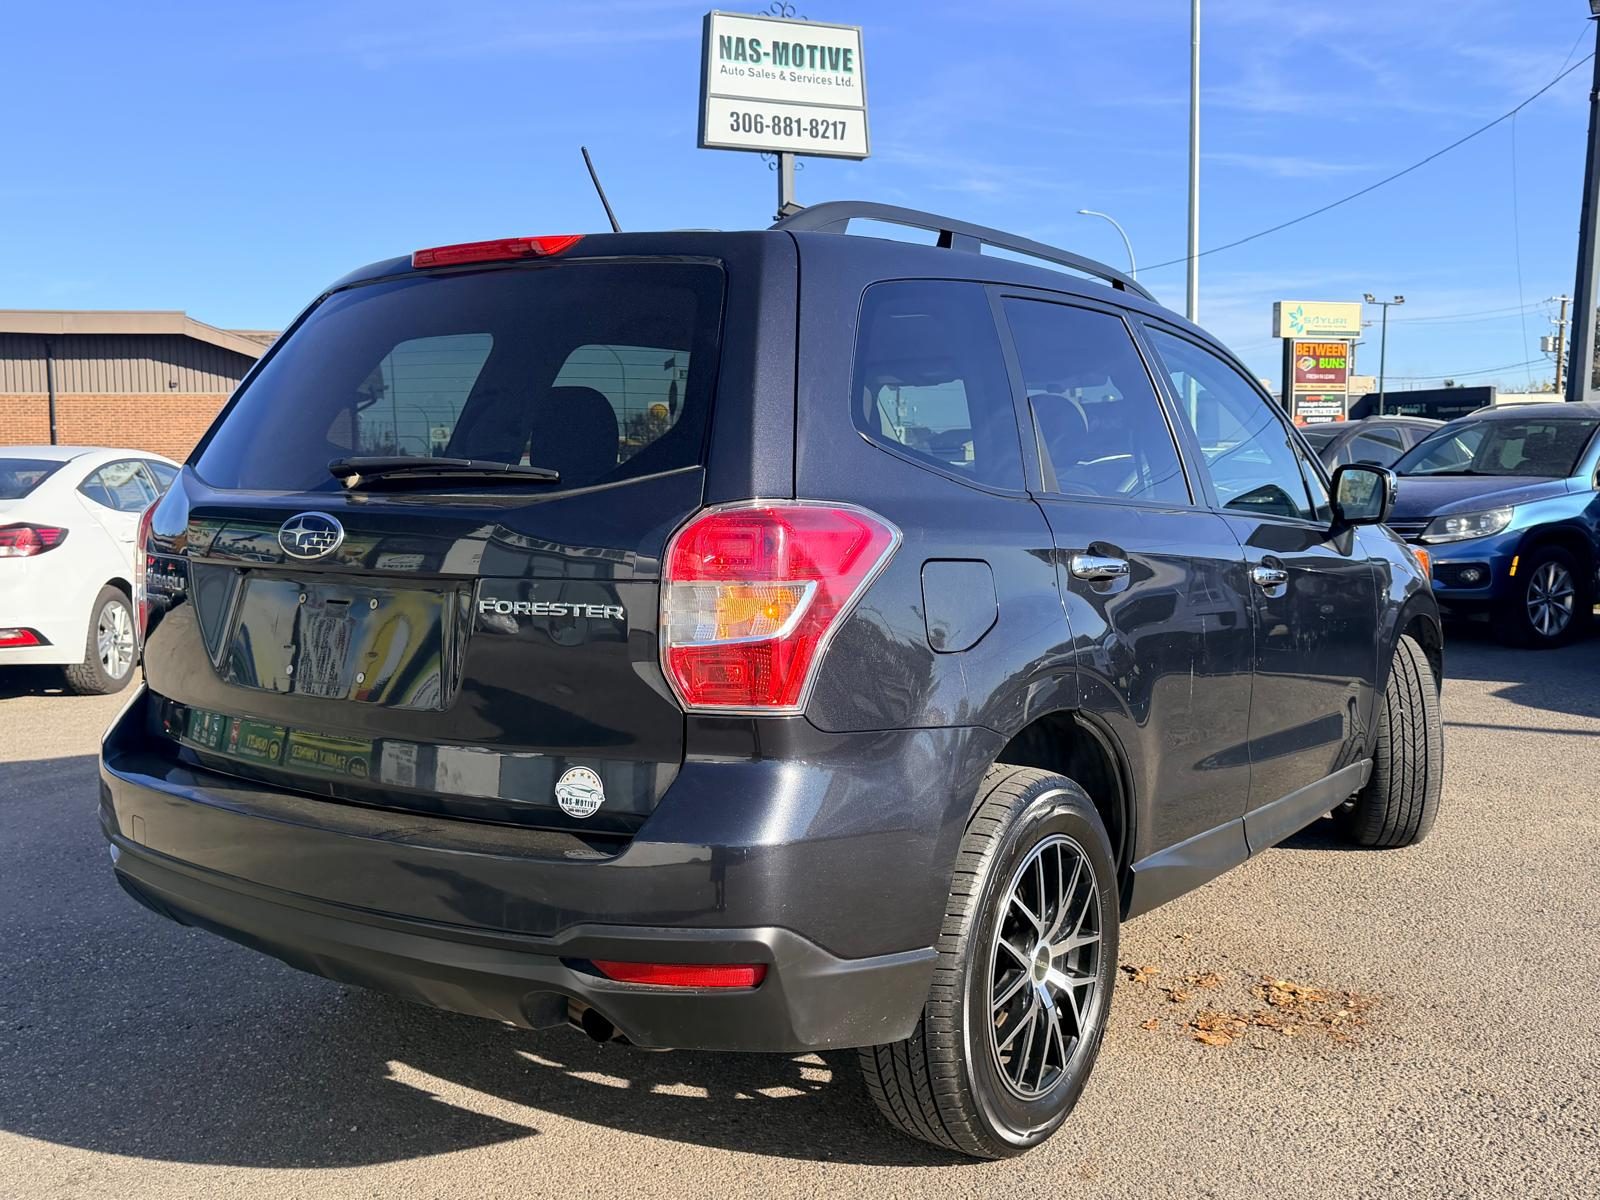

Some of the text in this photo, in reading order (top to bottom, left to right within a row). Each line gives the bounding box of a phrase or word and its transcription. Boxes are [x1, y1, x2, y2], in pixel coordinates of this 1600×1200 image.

[719, 34, 854, 73] NAS-MOTIVE
[720, 65, 854, 87] Auto Sales & Services Ltd.
[730, 111, 846, 141] 306-881-8217
[1303, 316, 1347, 325] SAYURI
[1296, 343, 1346, 356] BETWEEN
[1319, 358, 1346, 369] BUNS
[479, 600, 625, 621] FORESTER
[561, 797, 597, 809] NAS-MOTIVE
